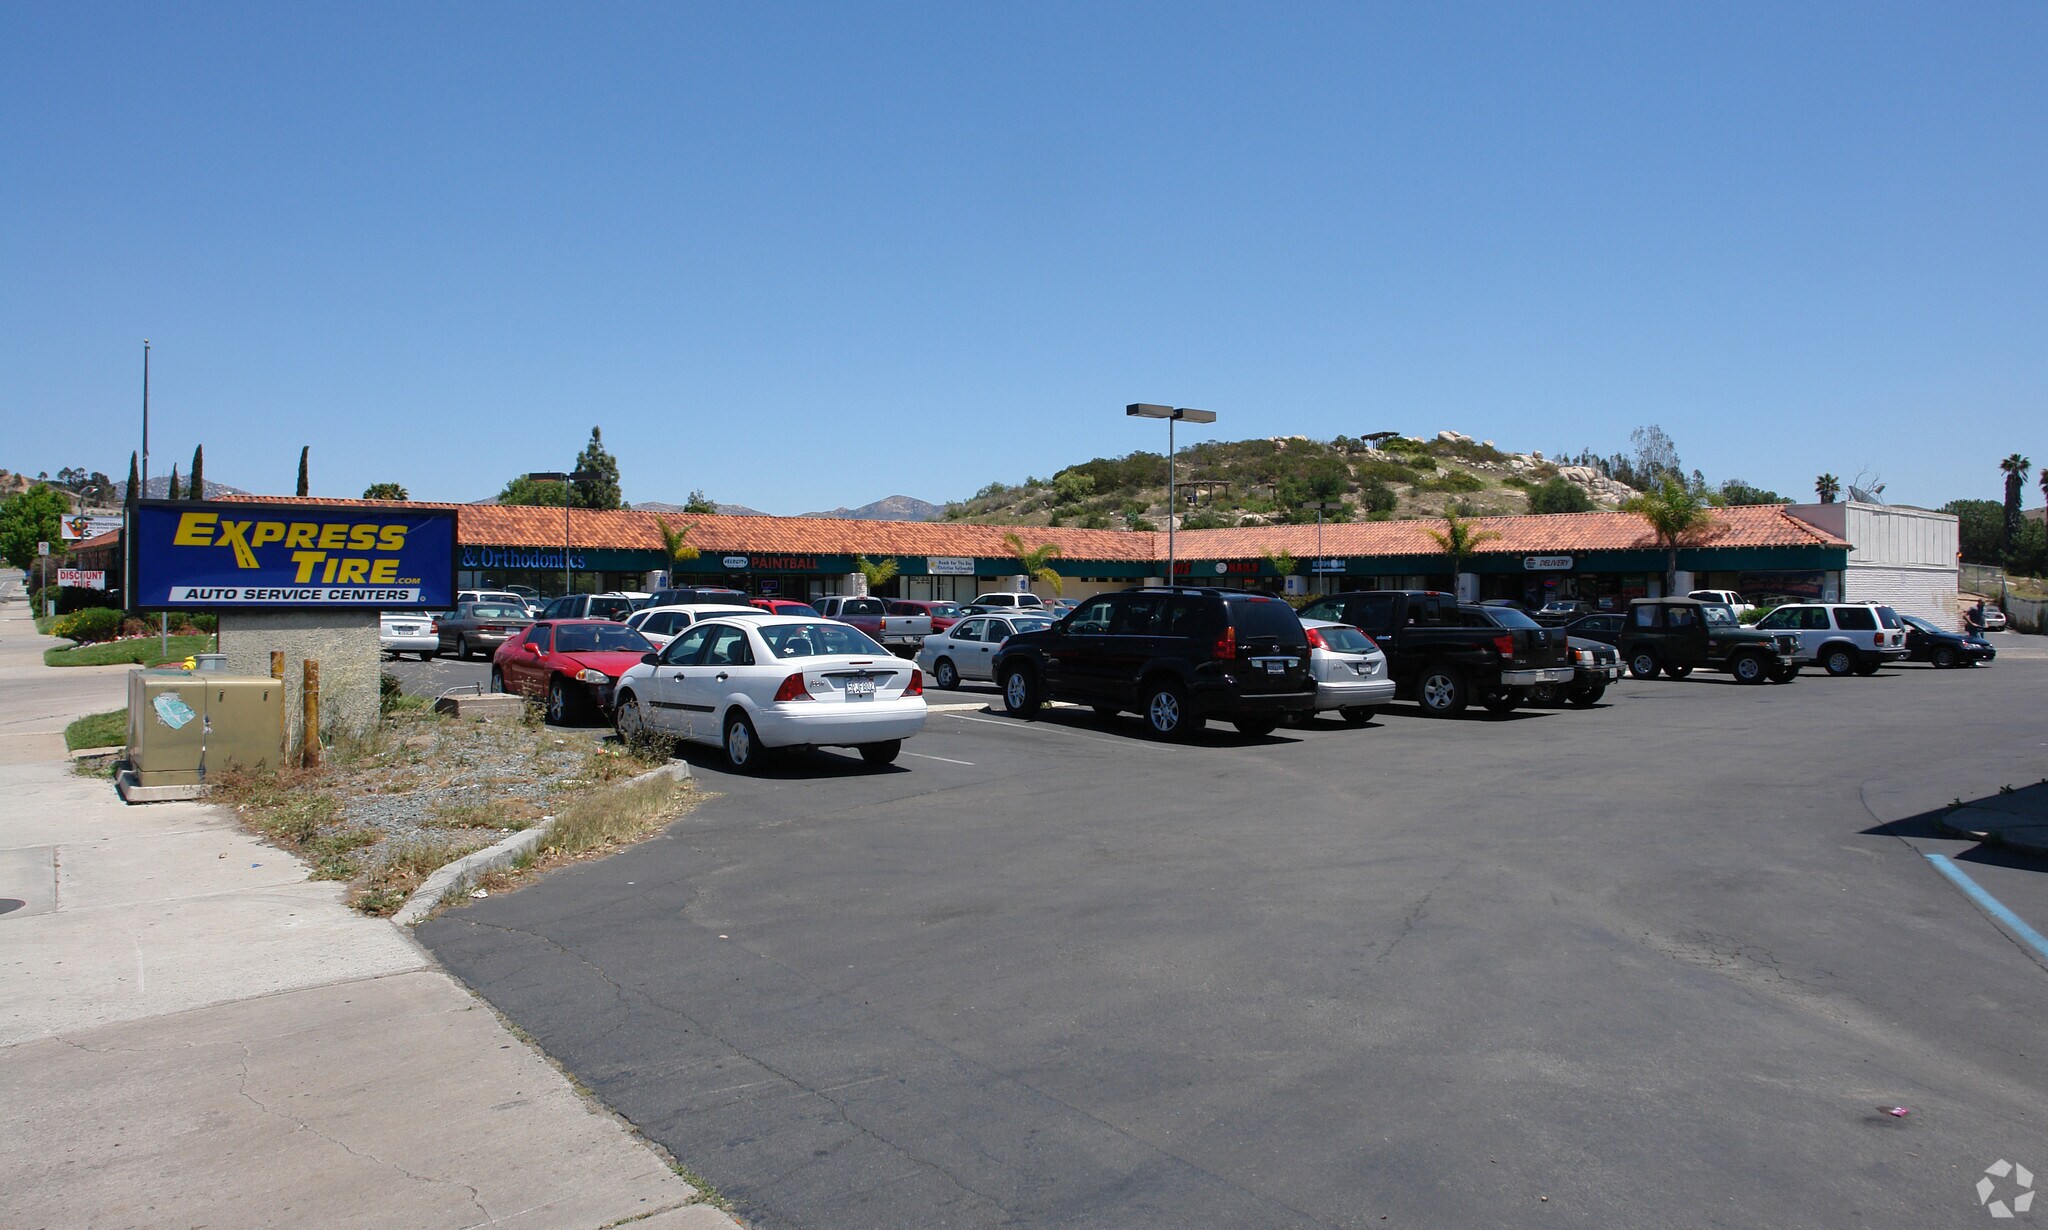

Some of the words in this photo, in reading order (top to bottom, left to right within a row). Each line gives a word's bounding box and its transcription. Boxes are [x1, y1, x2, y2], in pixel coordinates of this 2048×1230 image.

[173, 512, 408, 568] EXPRESS
[463, 547, 477, 567] &
[481, 548, 586, 568] Orthodontics
[751, 557, 819, 569] PAINTBALL
[185, 589, 238, 600] AUTO
[243, 589, 323, 600] SERVICE
[327, 589, 410, 601] CENTERS
